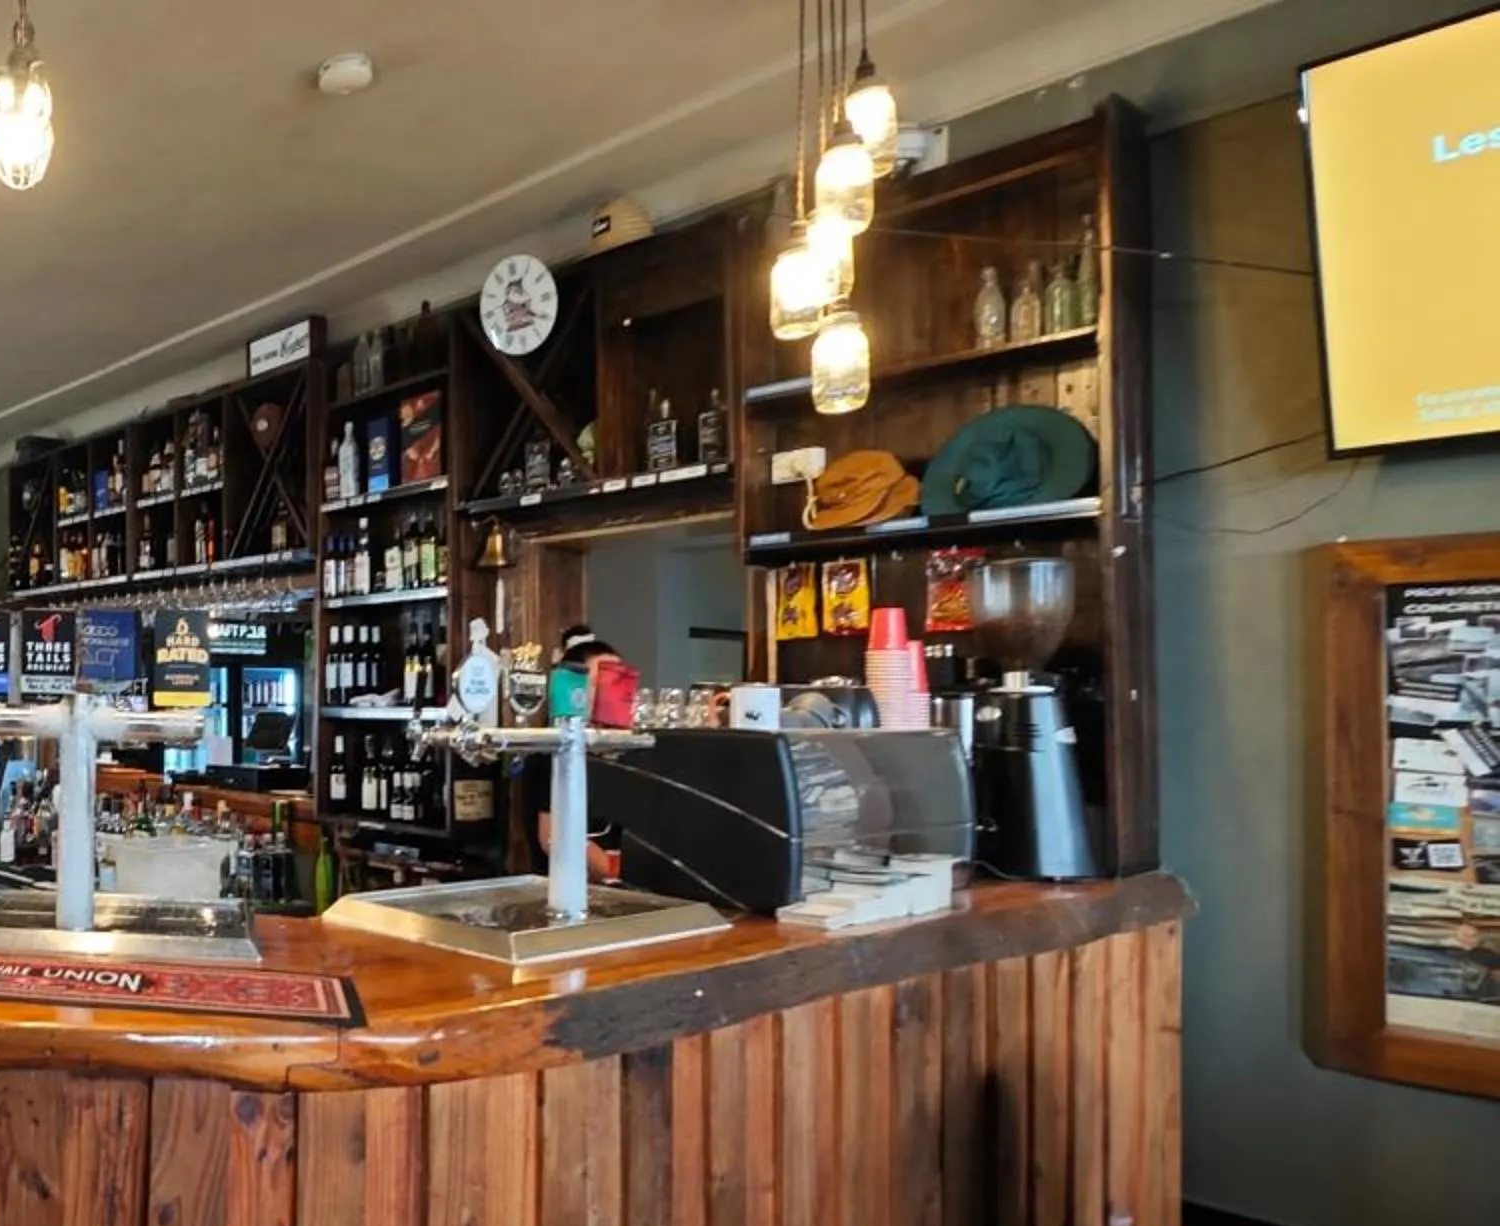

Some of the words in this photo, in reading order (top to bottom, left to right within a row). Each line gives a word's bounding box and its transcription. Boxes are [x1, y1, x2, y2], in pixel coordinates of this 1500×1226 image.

[26, 641, 71, 653] THREE
[26, 652, 71, 663] TAILS
[156, 647, 210, 665] RATED
[42, 969, 143, 993] UNION
